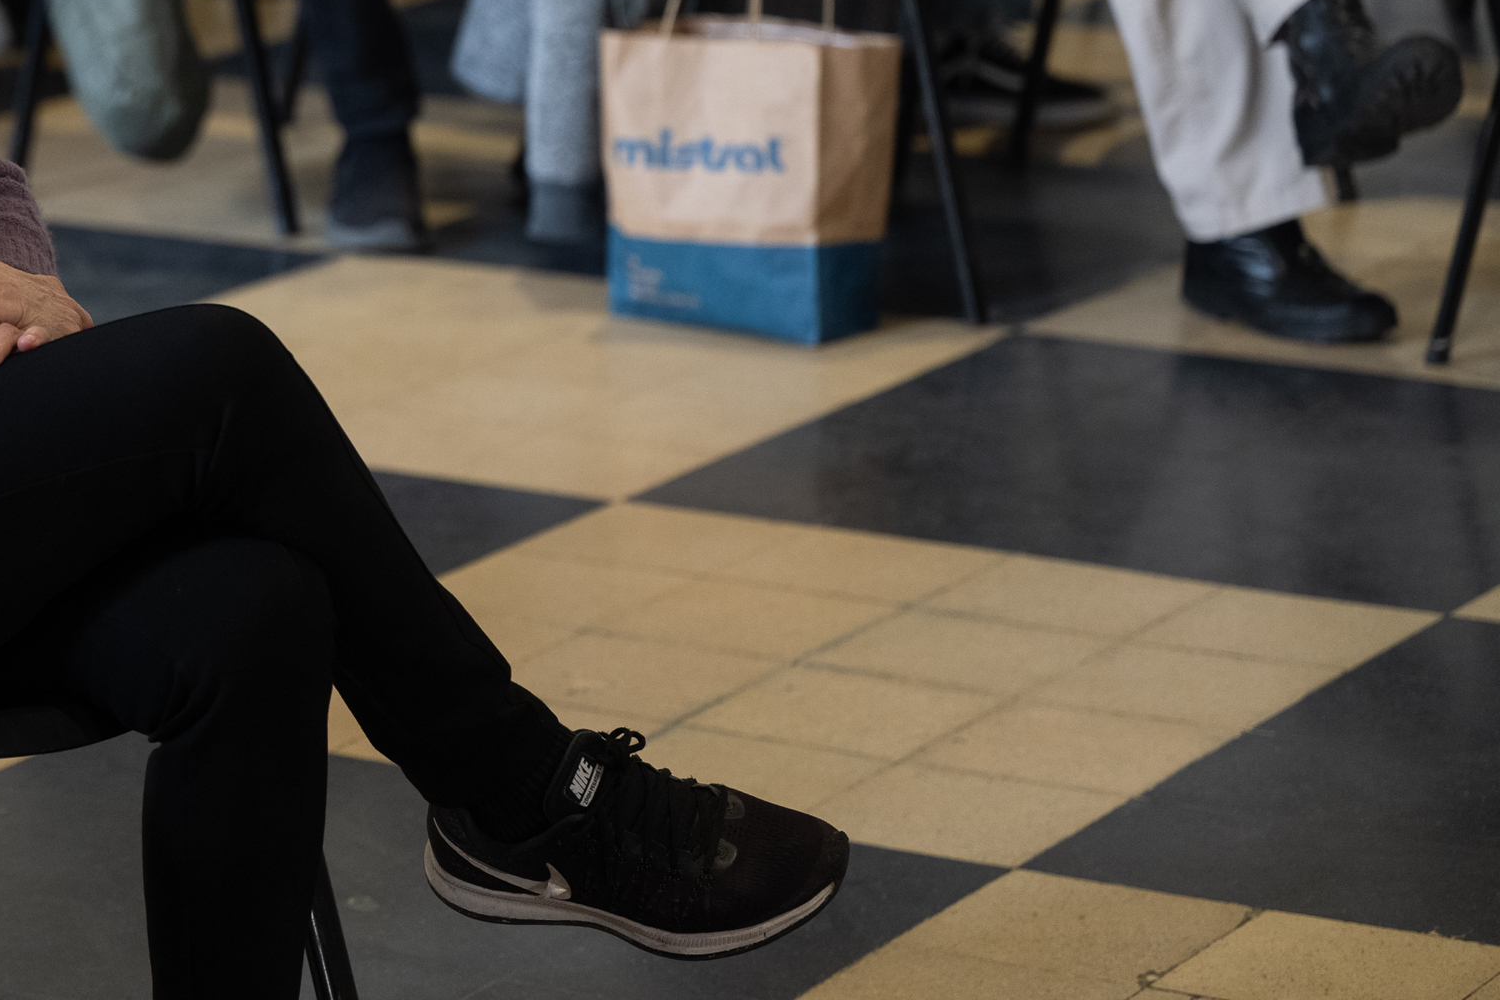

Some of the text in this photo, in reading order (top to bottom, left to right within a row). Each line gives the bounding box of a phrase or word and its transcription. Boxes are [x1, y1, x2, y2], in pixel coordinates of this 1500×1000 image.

[614, 128, 786, 174] mistral
[569, 756, 593, 800] NIKE
[582, 790, 592, 805] ZOOM
